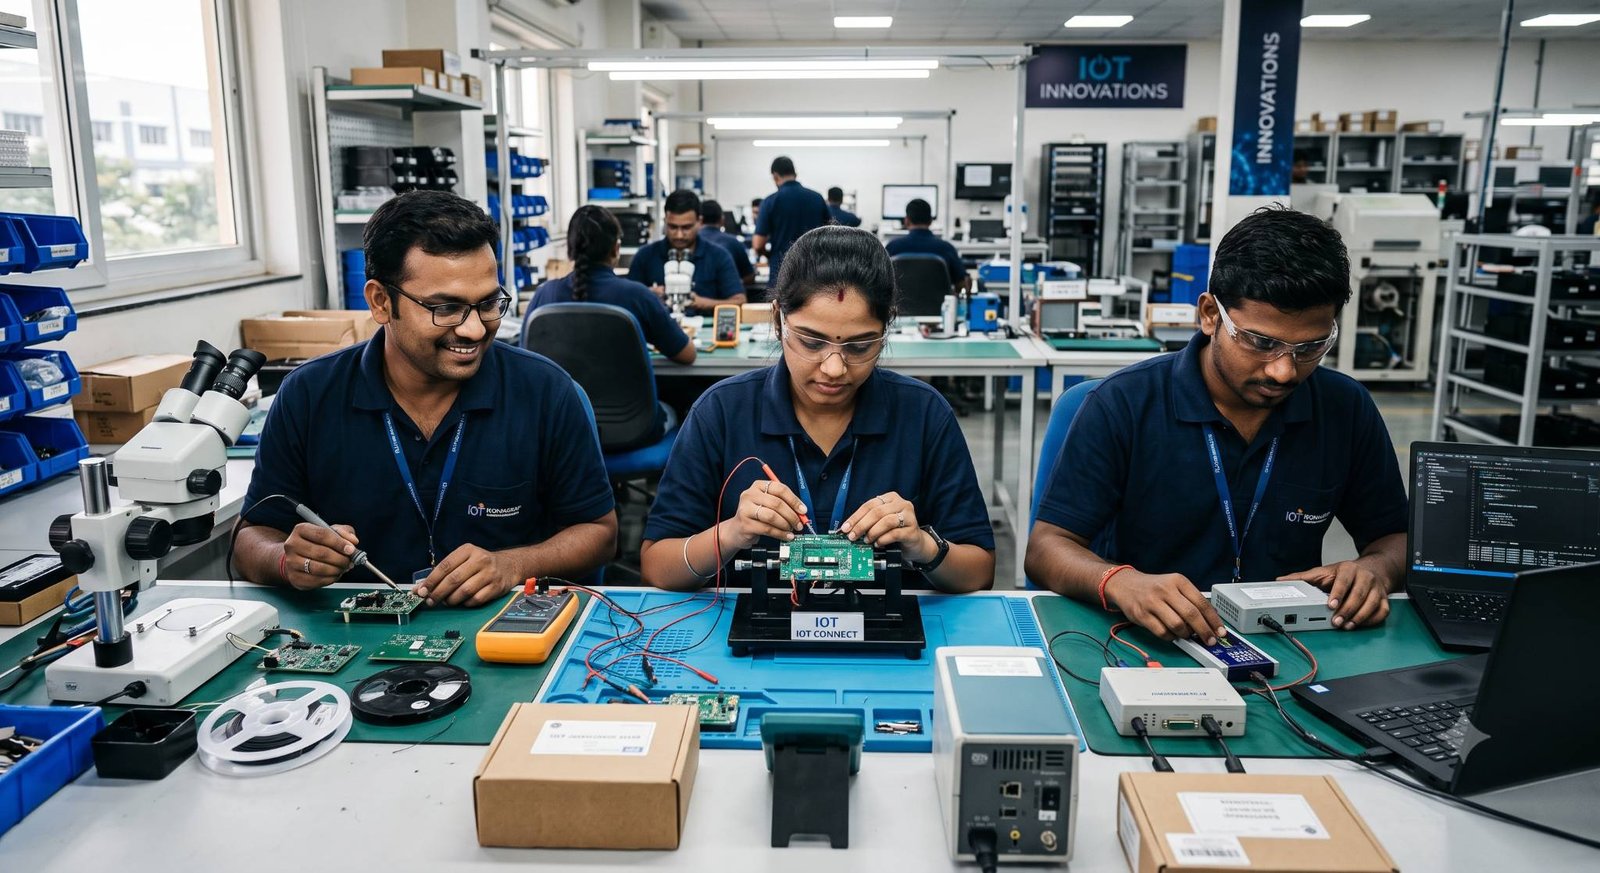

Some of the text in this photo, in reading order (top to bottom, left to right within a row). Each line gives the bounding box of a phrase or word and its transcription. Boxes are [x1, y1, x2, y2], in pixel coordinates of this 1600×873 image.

[1079, 55, 1132, 80] IOT
[1039, 82, 1169, 100] INNOVATIONS
[1256, 31, 1281, 164] INNOVATIONS
[815, 616, 839, 627] IOT
[796, 629, 858, 638] IOT CONNECT
